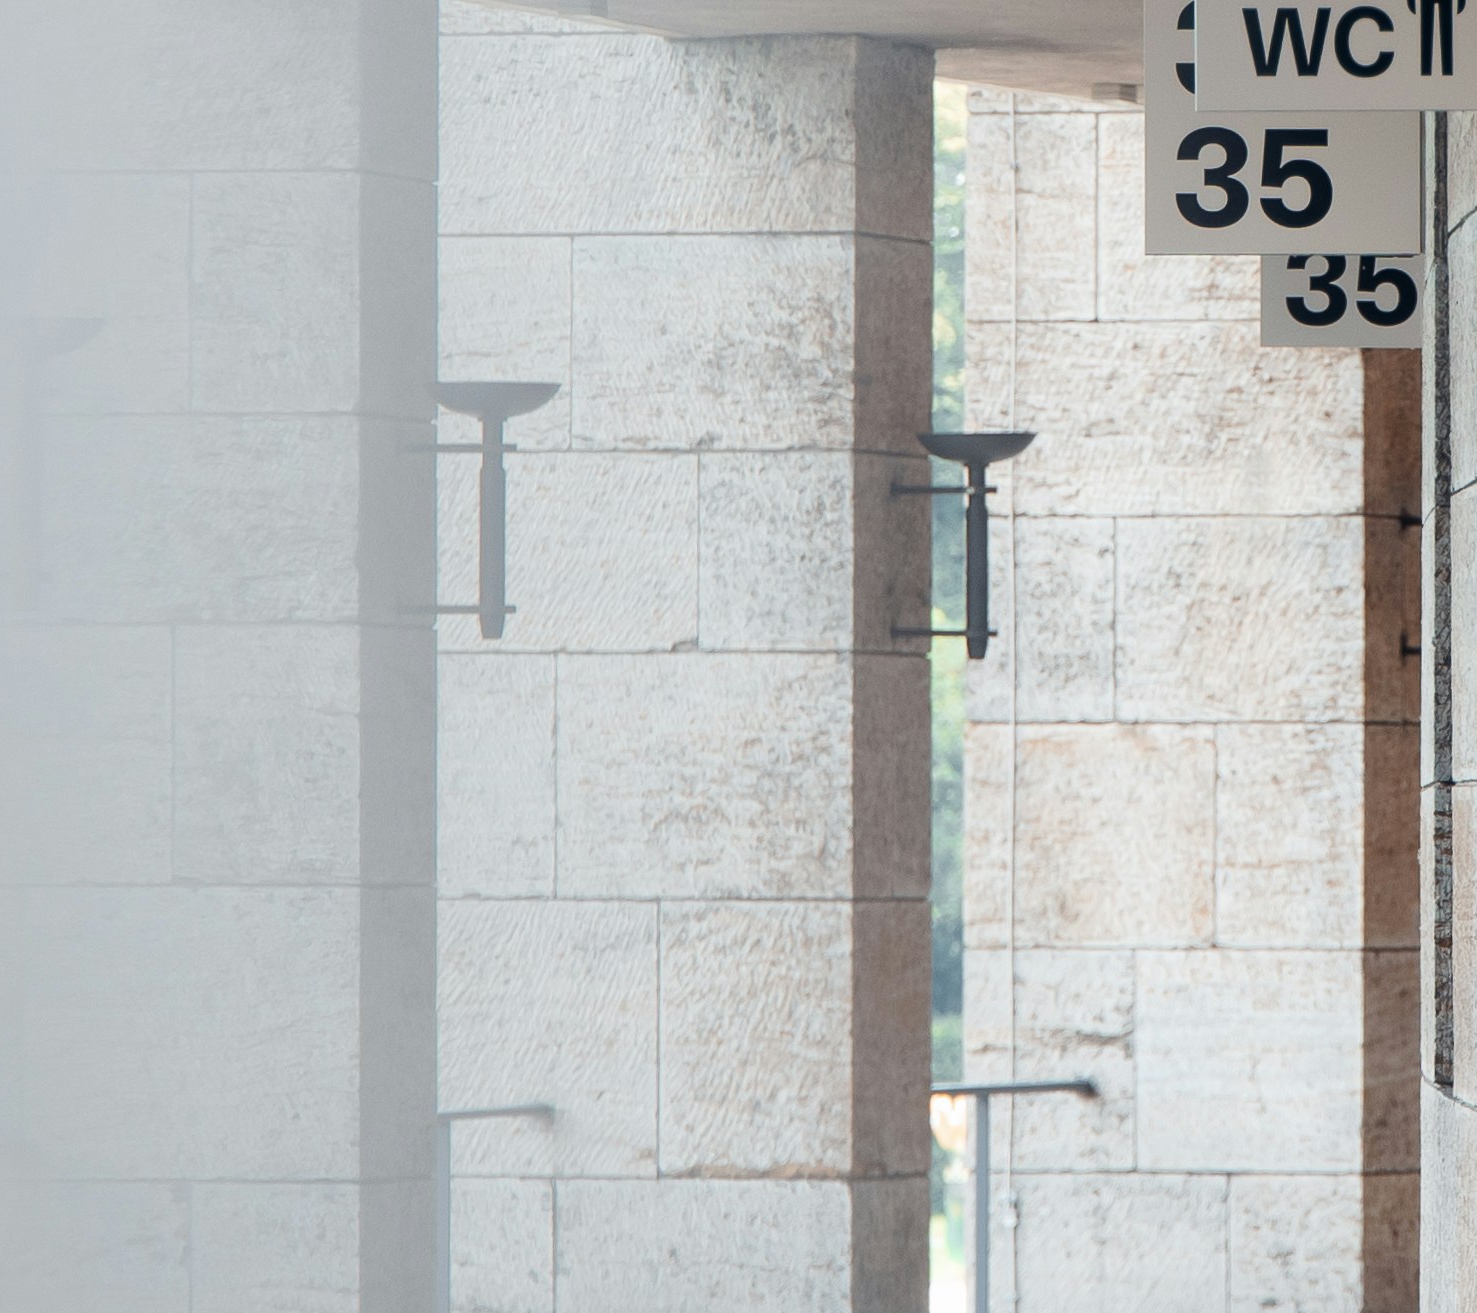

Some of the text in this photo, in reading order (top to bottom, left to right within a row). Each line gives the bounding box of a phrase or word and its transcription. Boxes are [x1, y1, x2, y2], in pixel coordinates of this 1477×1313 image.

[1241, 5, 1395, 78] WC
[1175, 126, 1333, 229] 35
[1285, 257, 1418, 327] 35
